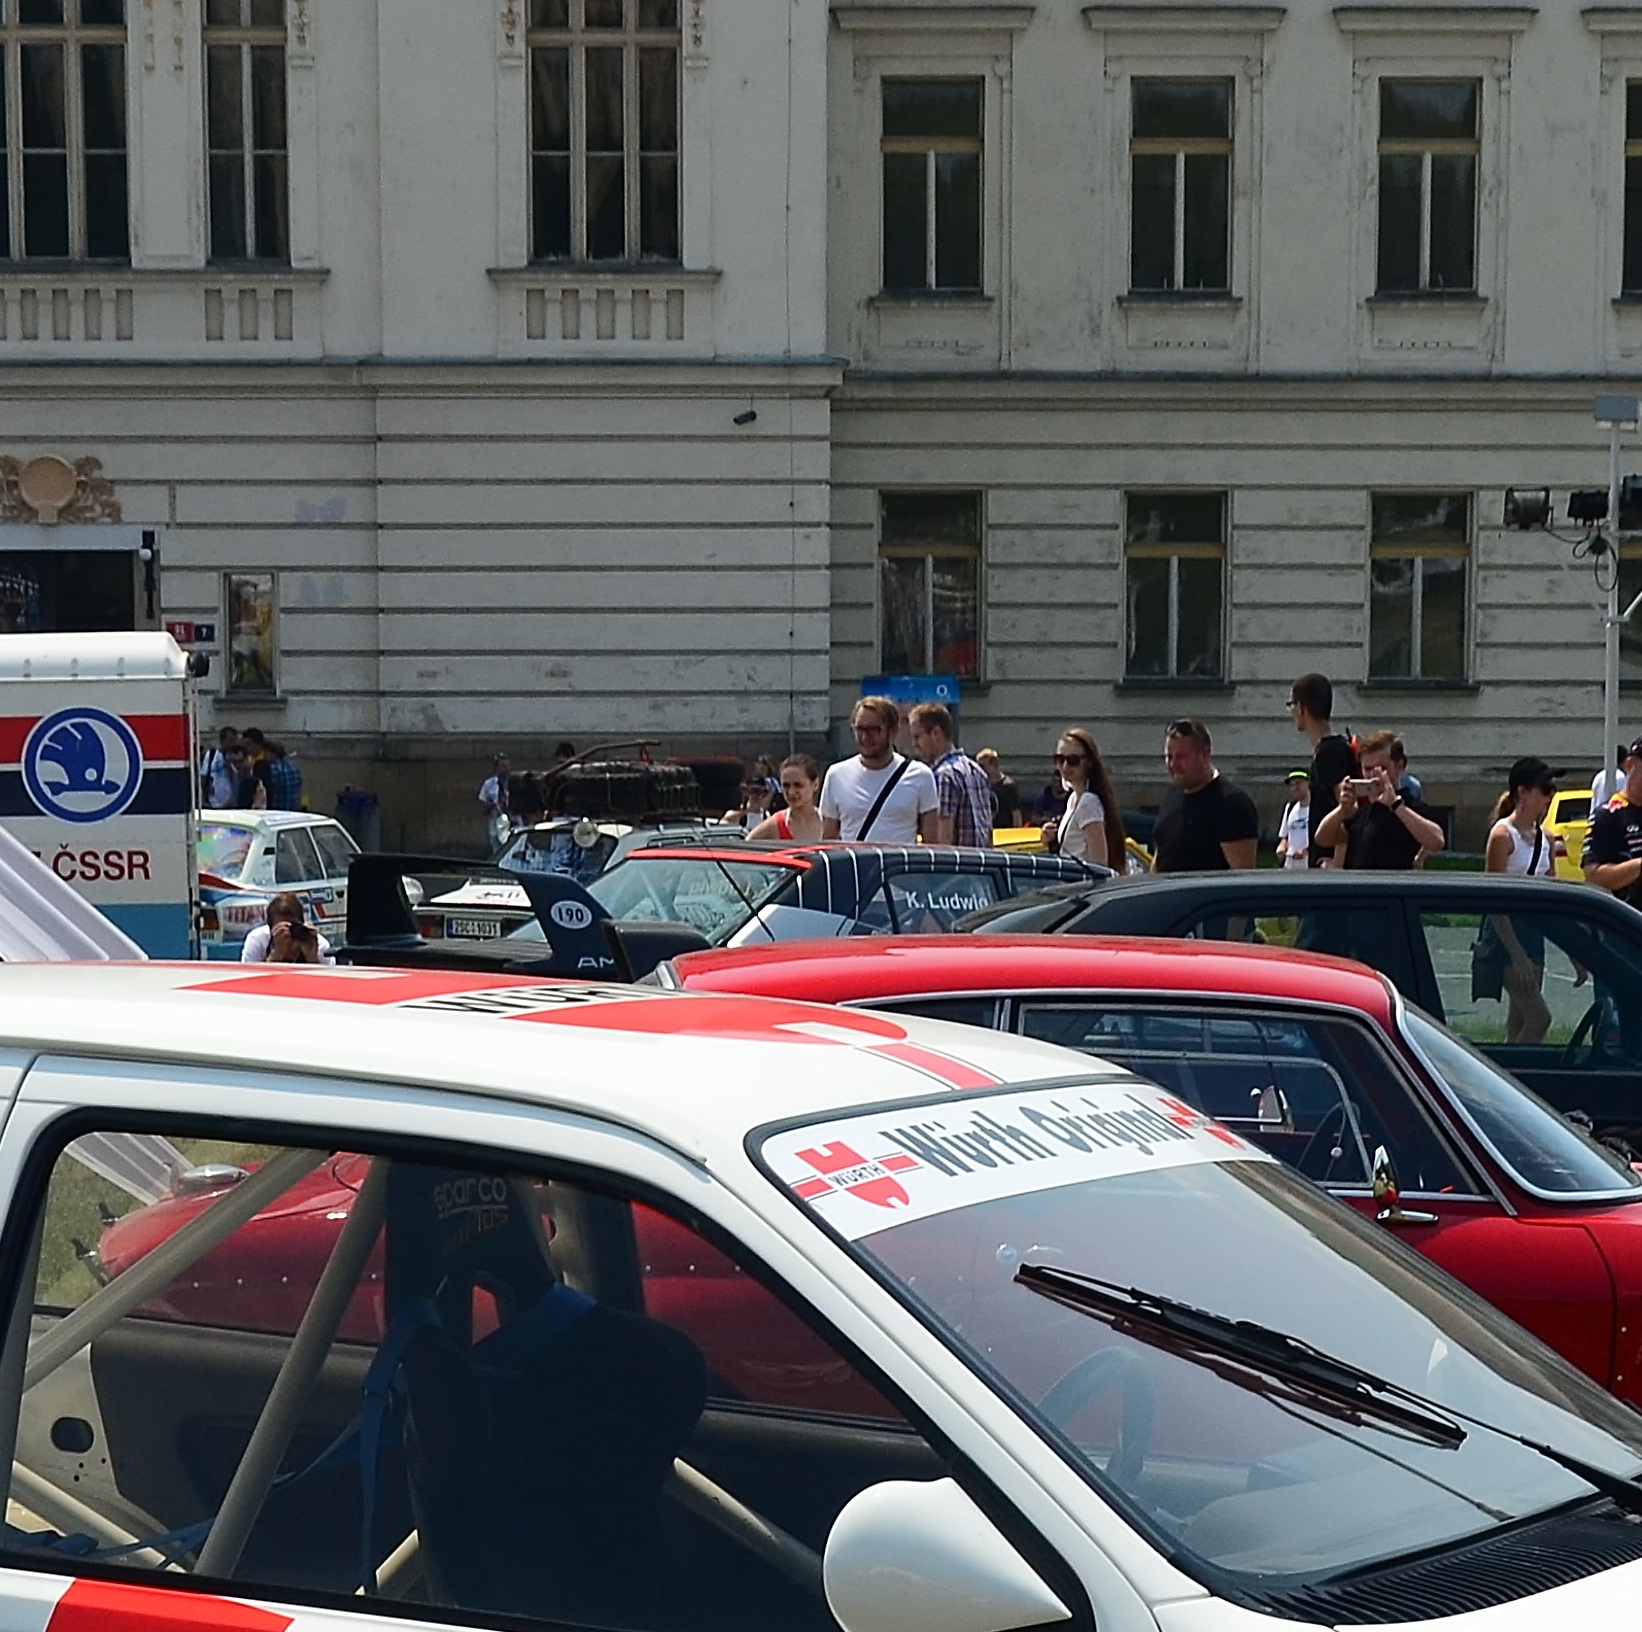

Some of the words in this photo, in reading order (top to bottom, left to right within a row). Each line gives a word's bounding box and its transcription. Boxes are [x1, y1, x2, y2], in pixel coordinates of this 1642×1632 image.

[51, 843, 152, 881] ČSSR
[906, 893, 925, 909] K.
[557, 906, 585, 922] 190
[577, 957, 615, 969] AM
[879, 1109, 1059, 1178] Würth
[1018, 1093, 1196, 1156] Original
[829, 1163, 886, 1189] WÜRTH
